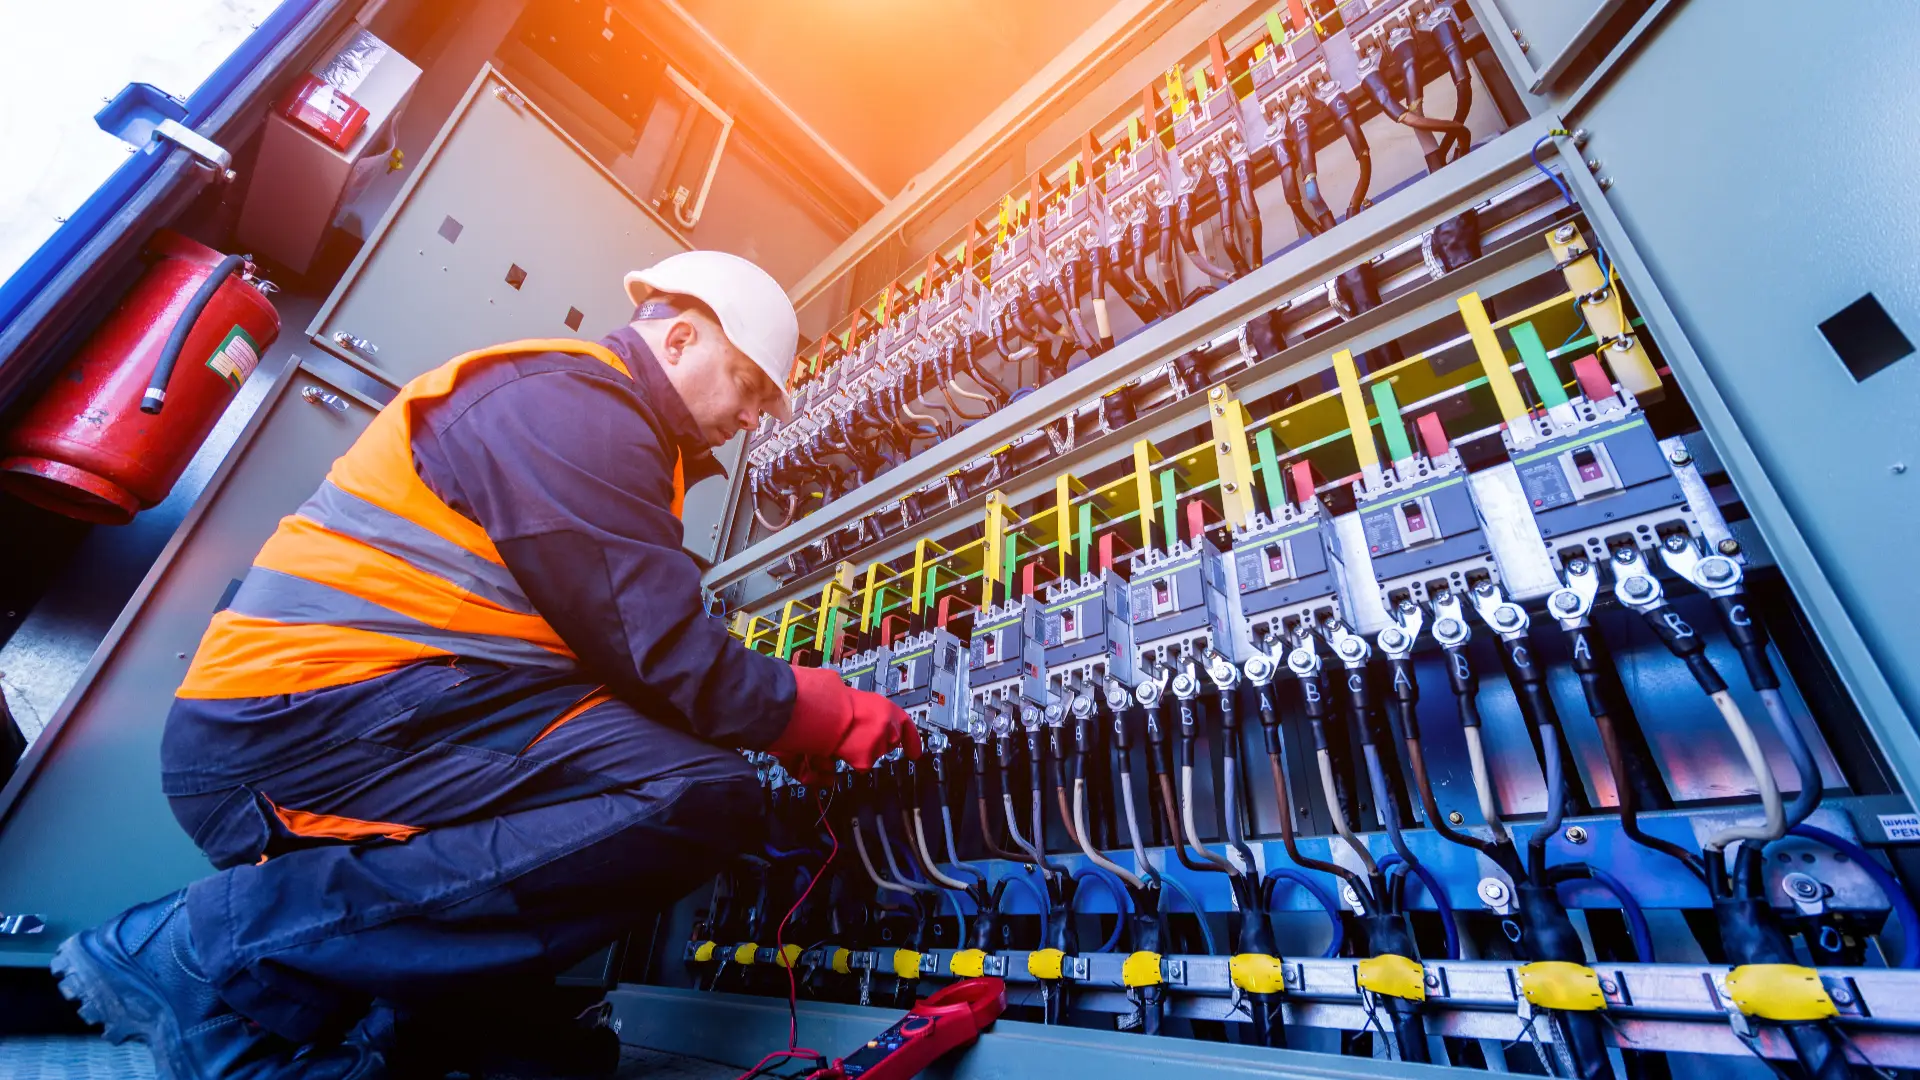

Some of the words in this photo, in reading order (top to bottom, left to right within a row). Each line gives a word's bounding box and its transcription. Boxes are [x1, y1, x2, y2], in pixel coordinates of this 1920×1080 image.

[1296, 118, 1307, 132] B
[1276, 144, 1288, 160] A
[1216, 178, 1226, 191] B
[1178, 199, 1189, 212] A
[1729, 605, 1751, 627] C
[1663, 612, 1693, 639] B
[1574, 633, 1591, 660] A
[1513, 646, 1530, 668] C
[1454, 654, 1470, 680] B
[1348, 670, 1362, 692] C
[1394, 669, 1411, 692] A
[1306, 683, 1321, 702] B
[1221, 698, 1231, 712] C
[1260, 693, 1272, 711] A
[1148, 714, 1158, 733] A
[1181, 707, 1193, 725] B
[1075, 726, 1082, 741] B
[1114, 719, 1121, 733] C
[1050, 734, 1057, 752] A
[1891, 828, 1920, 838] PEN
